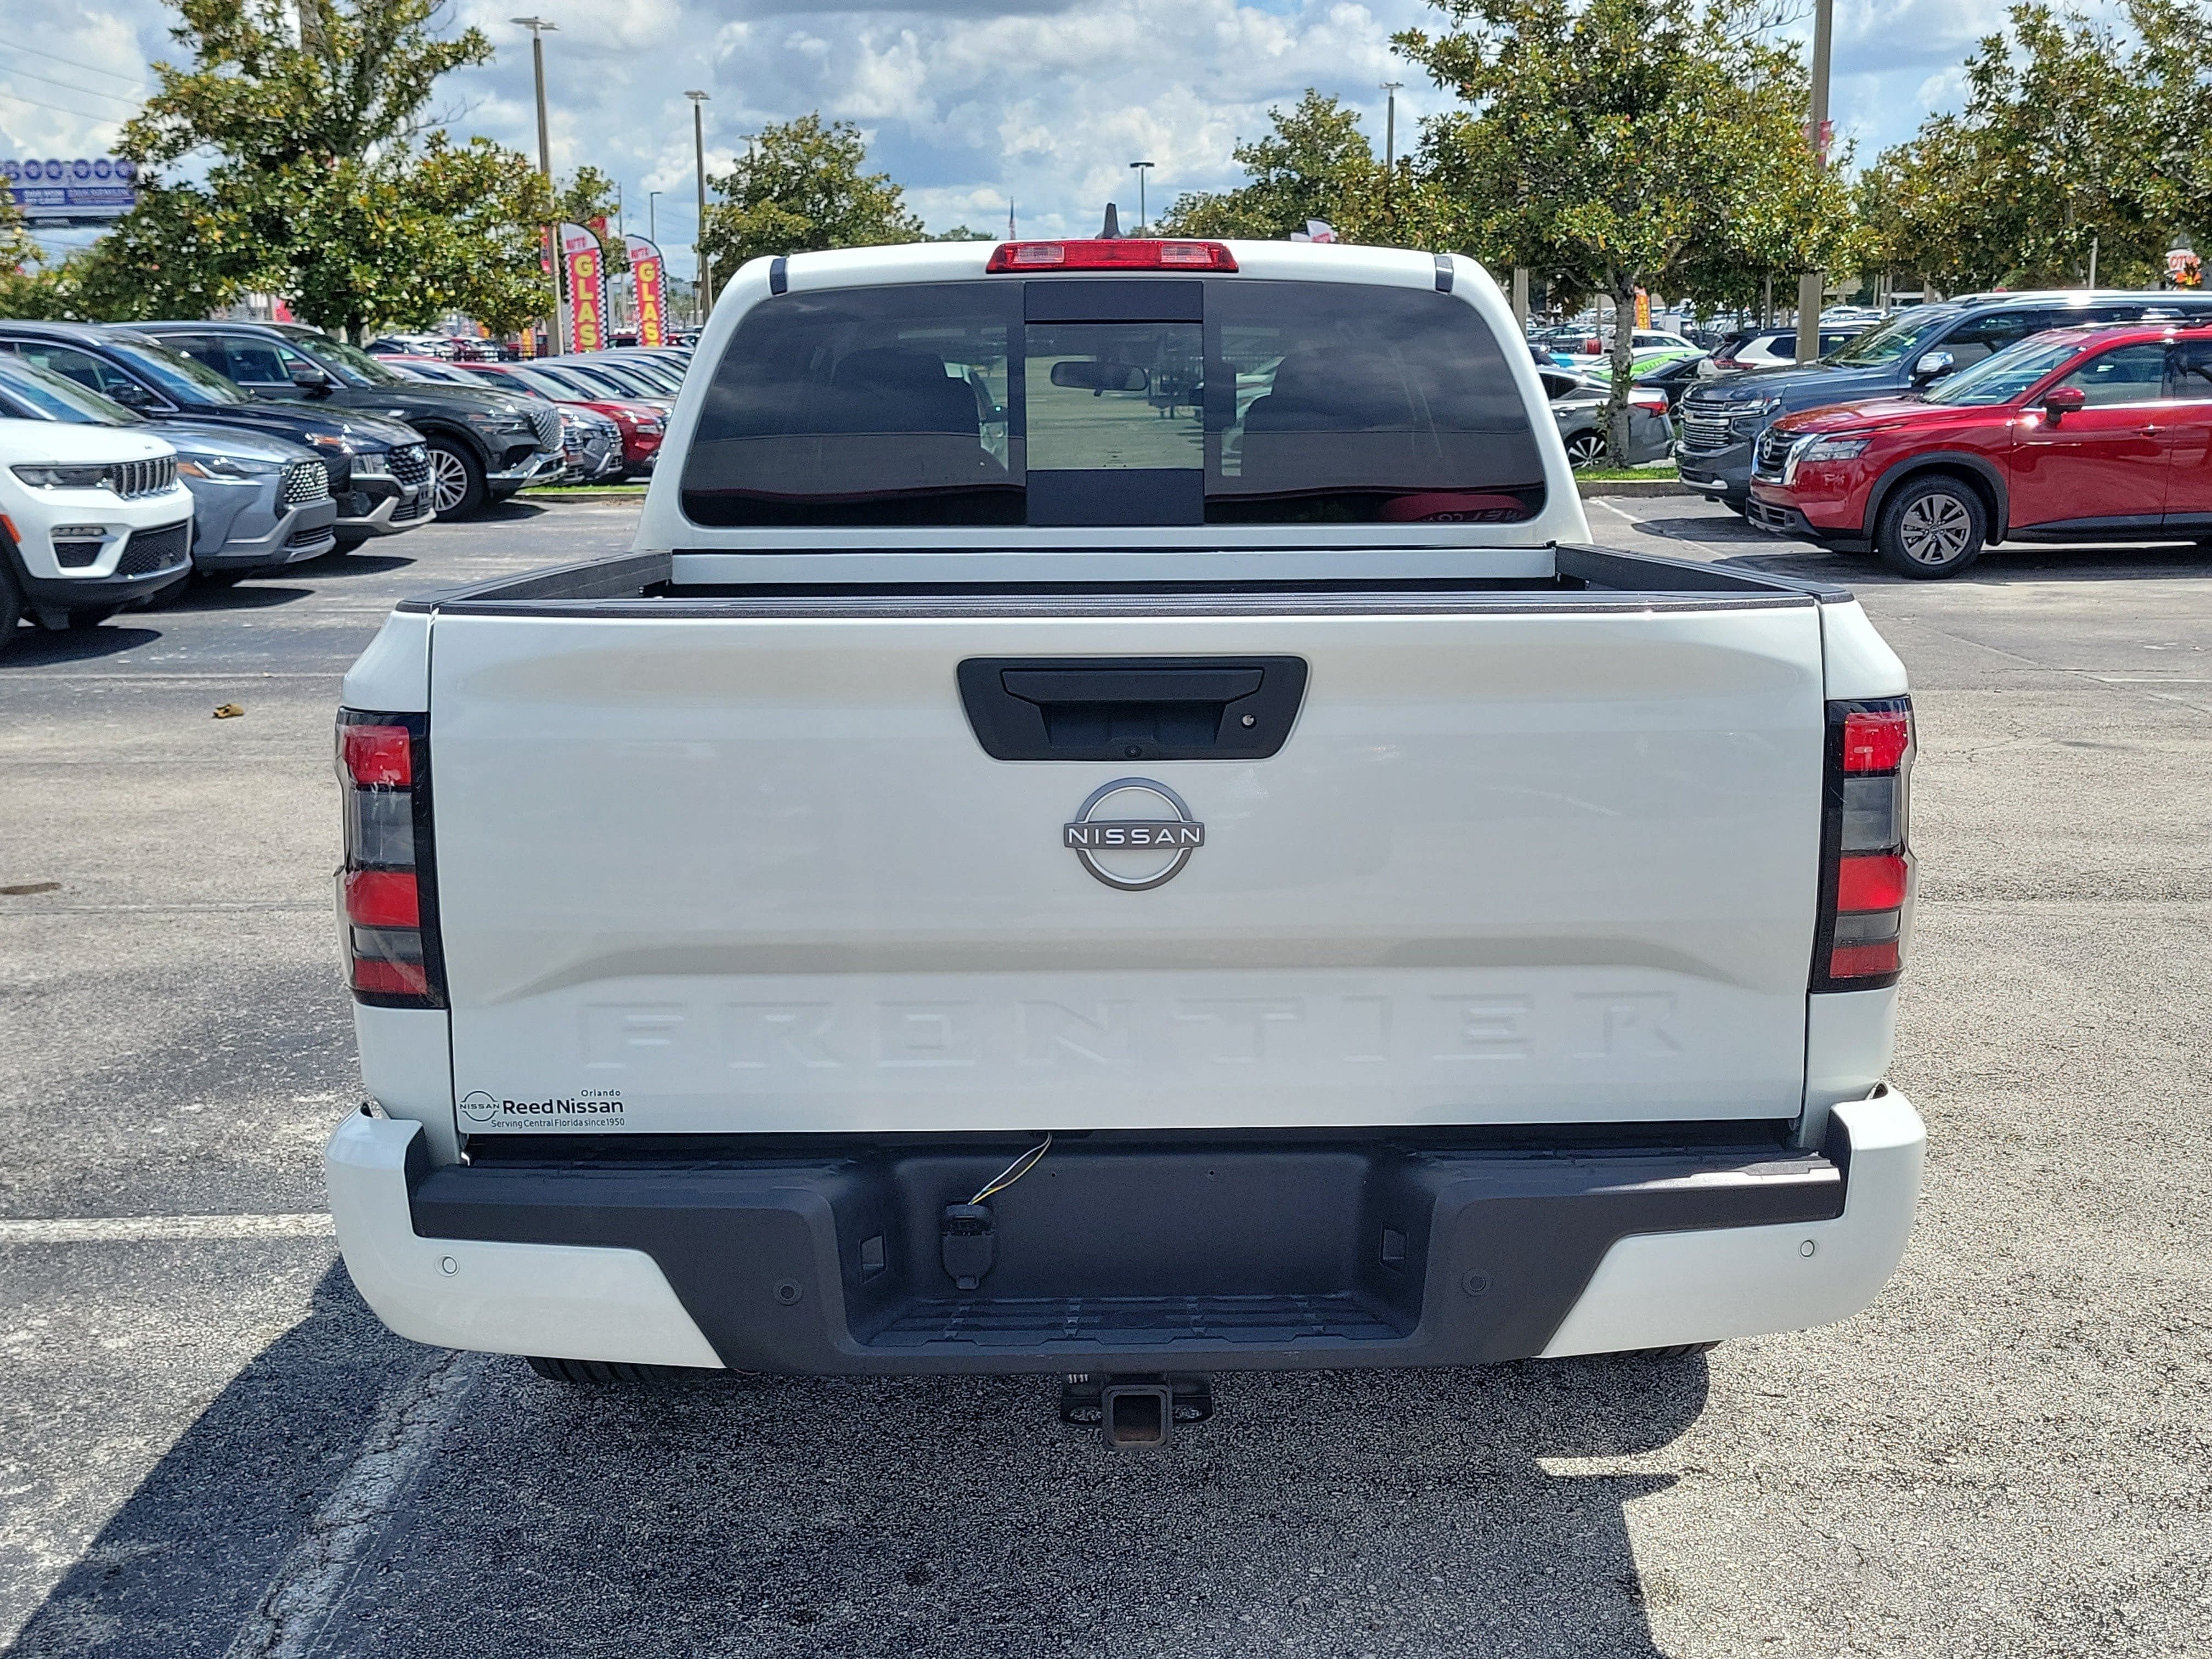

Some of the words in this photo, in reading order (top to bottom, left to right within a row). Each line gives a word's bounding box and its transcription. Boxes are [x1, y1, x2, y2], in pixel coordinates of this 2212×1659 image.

[575, 255, 597, 352] GLAS
[639, 263, 659, 347] GLAS
[1069, 828, 1200, 844] NISSAN
[580, 992, 1685, 1068] FRONTIER
[492, 1120, 522, 1128] Serving
[555, 1119, 583, 1127] Florida
[584, 1118, 605, 1126] since
[606, 1118, 624, 1126] 1950
[503, 1099, 553, 1114] Reed
[556, 1098, 624, 1114] Nissan
